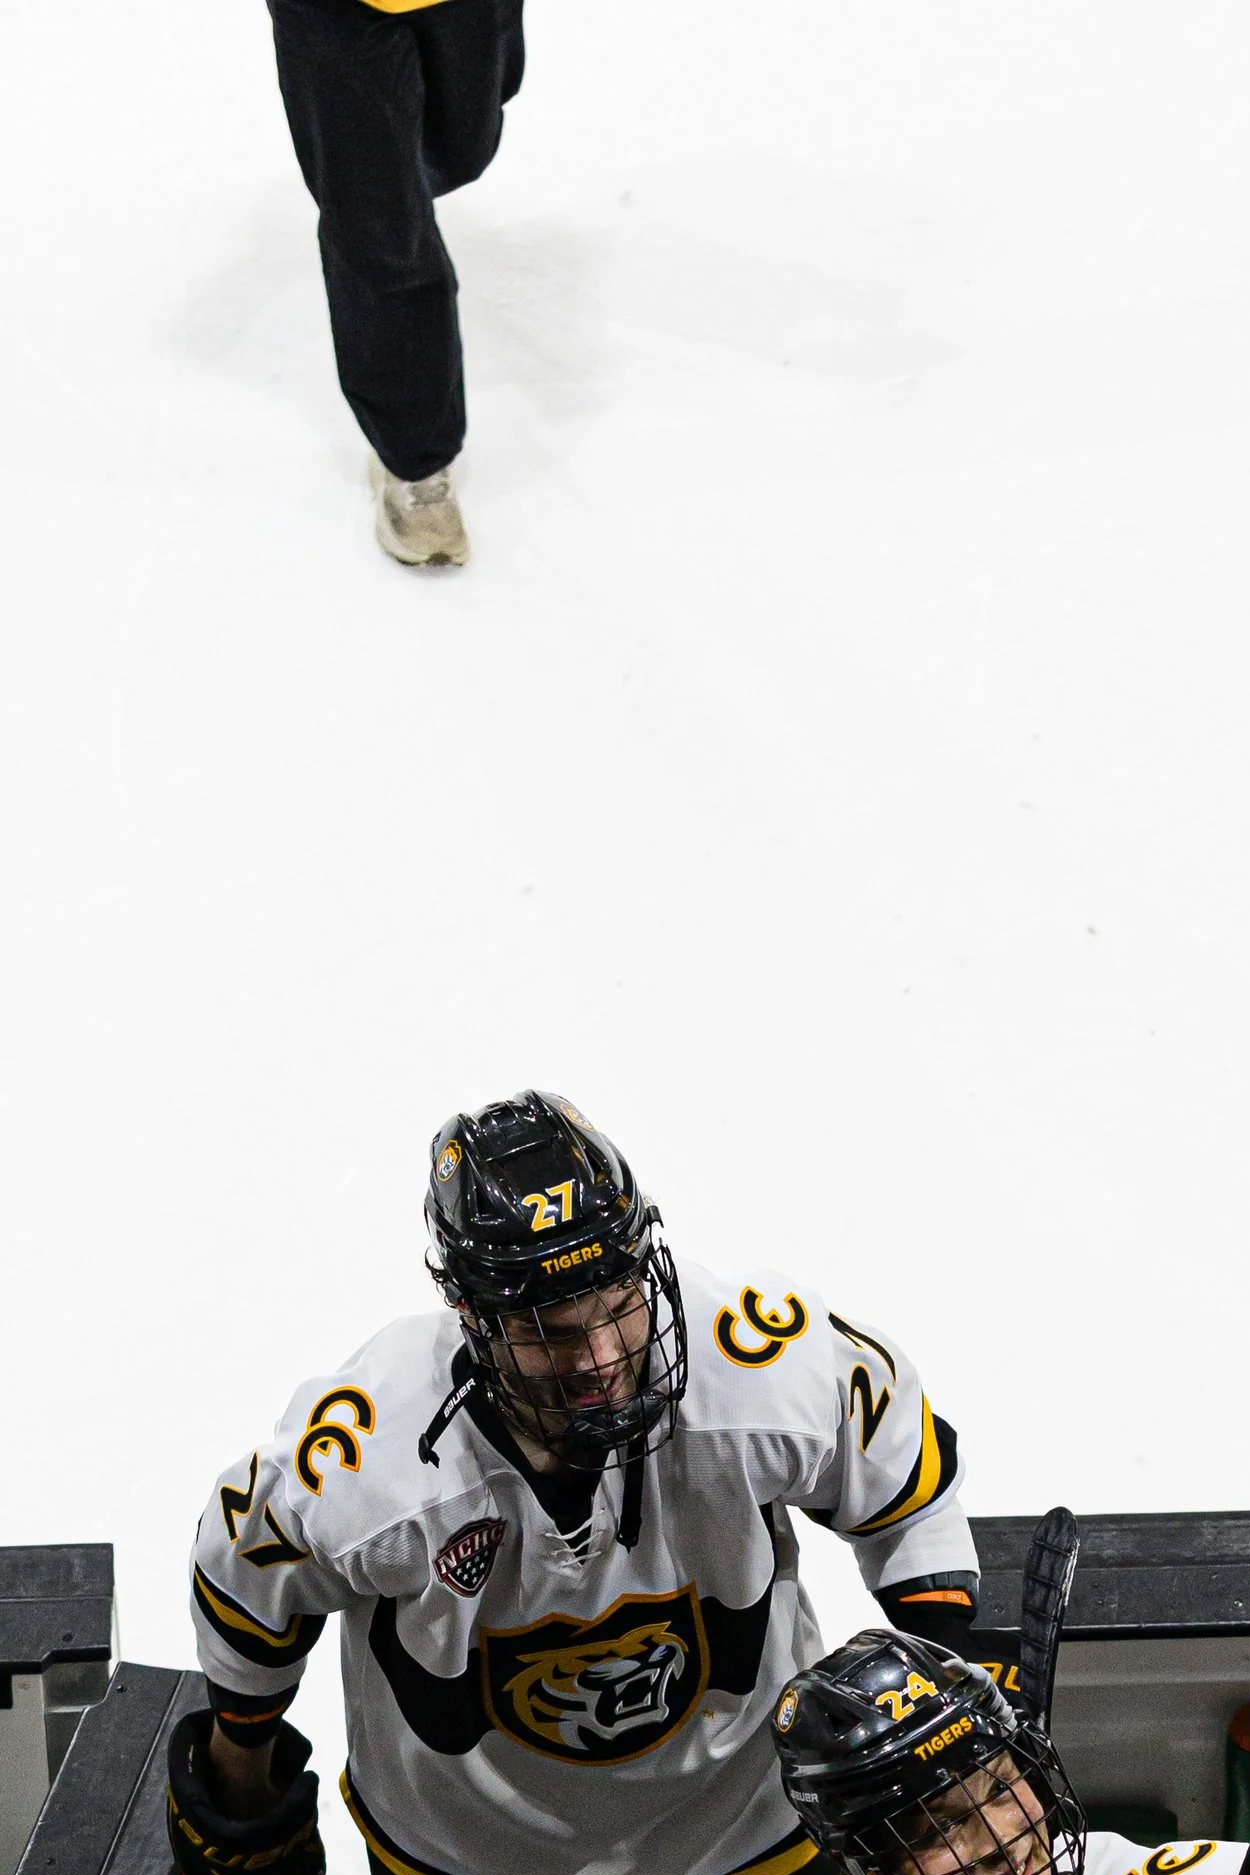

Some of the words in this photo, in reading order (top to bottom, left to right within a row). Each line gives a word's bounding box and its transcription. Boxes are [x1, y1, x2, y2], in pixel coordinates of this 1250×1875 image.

[522, 1179, 577, 1232] 27
[541, 1242, 603, 1275] TIGERS
[443, 1378, 476, 1418] BAUER
[875, 1671, 939, 1724] 24
[914, 1716, 973, 1761] TIGERS
